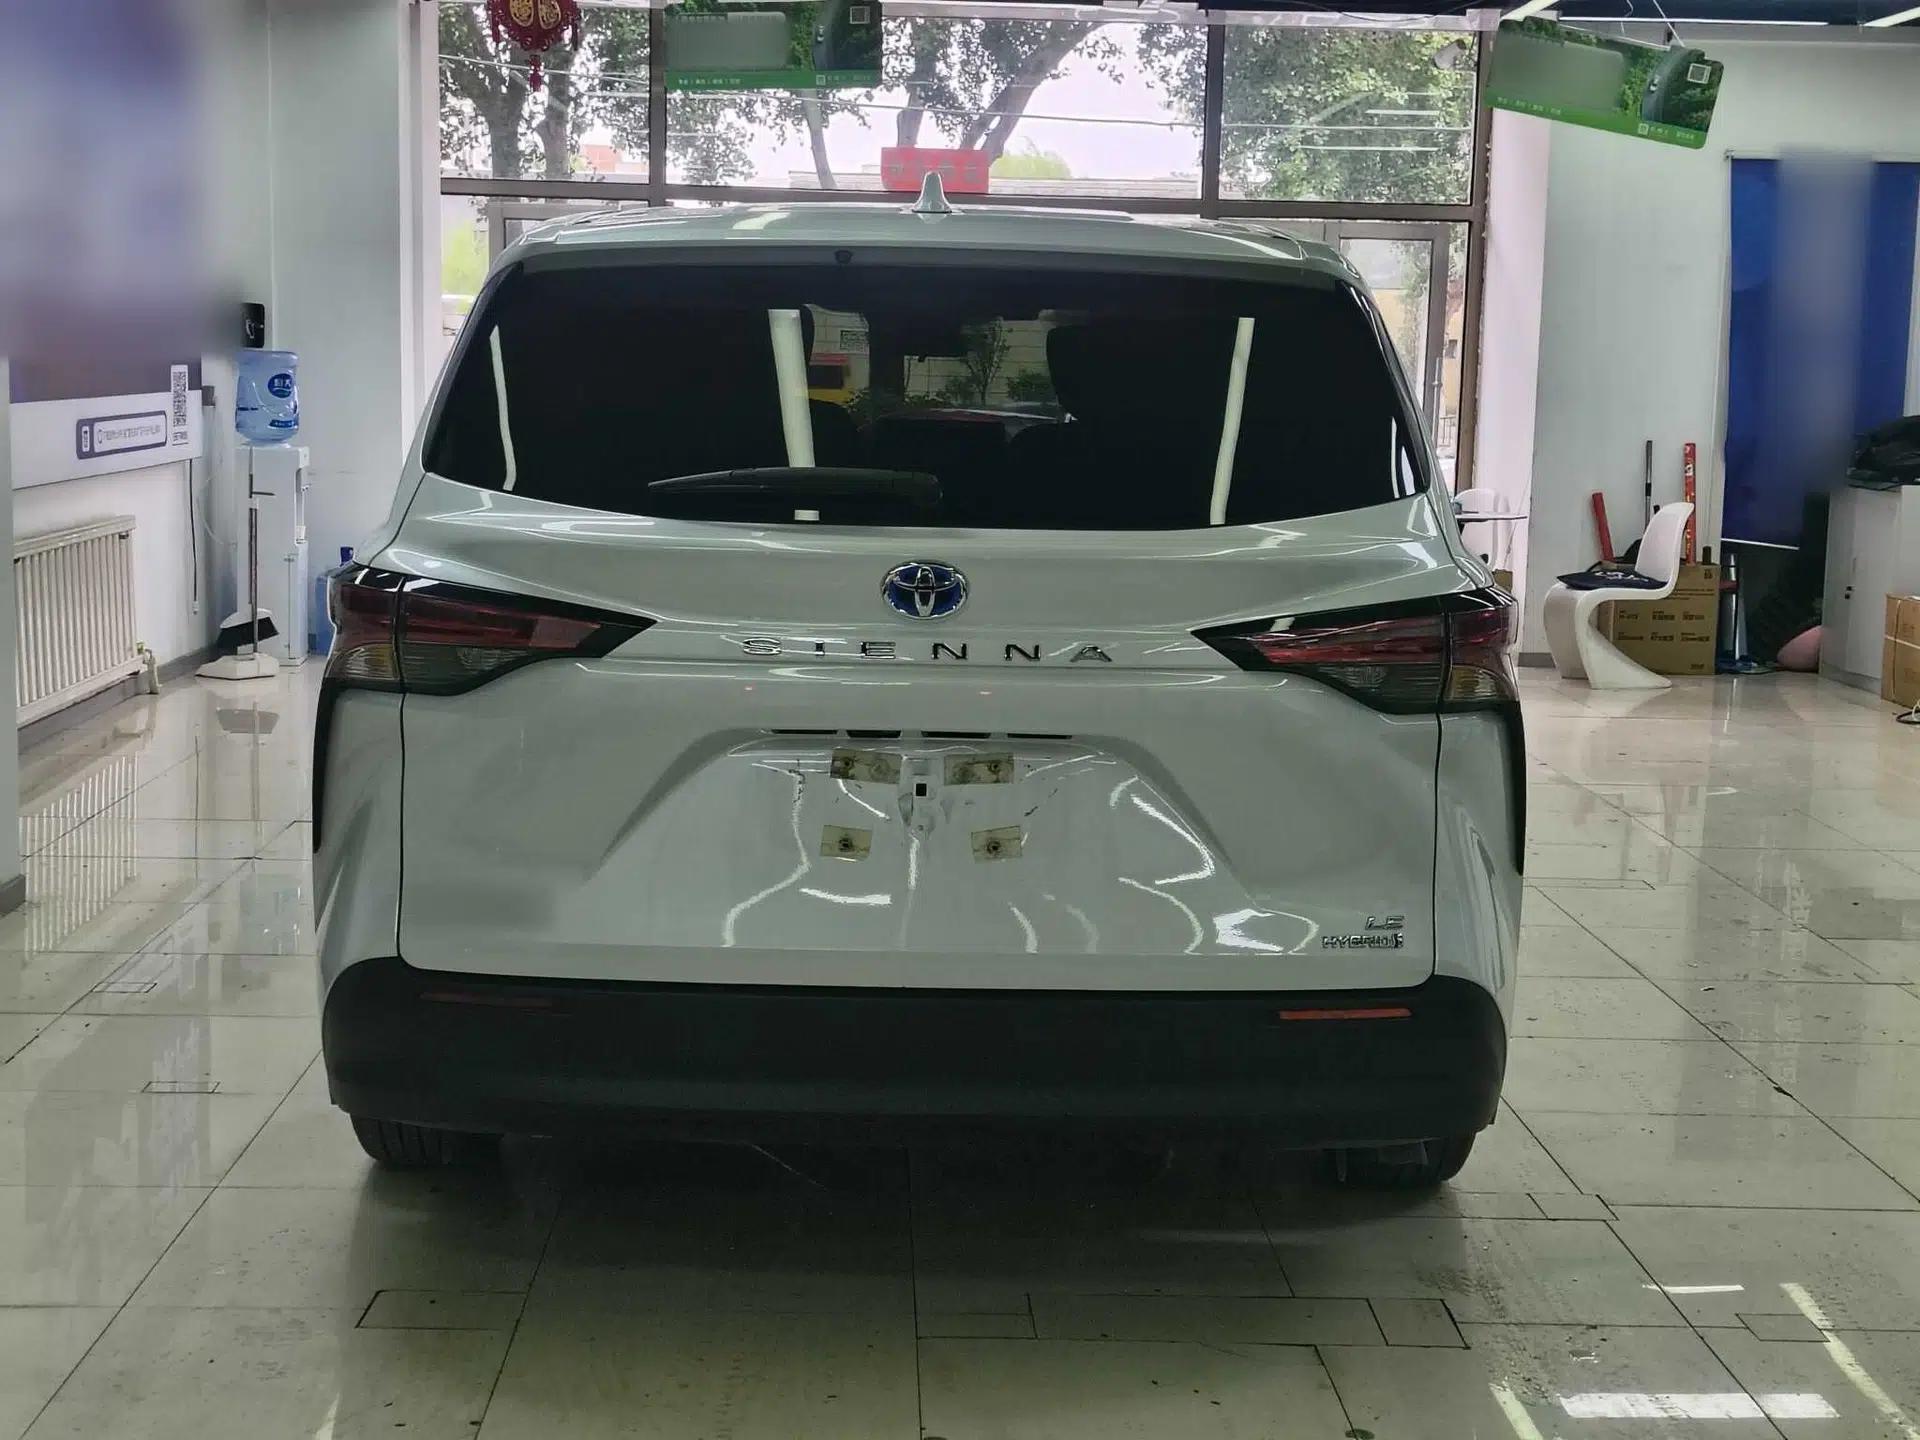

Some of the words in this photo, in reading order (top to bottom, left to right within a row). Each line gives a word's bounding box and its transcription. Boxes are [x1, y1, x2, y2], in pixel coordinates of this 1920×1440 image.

[742, 637, 1112, 662] SIENNA
[1365, 915, 1404, 930] LE
[1322, 935, 1396, 949] HYBRID
